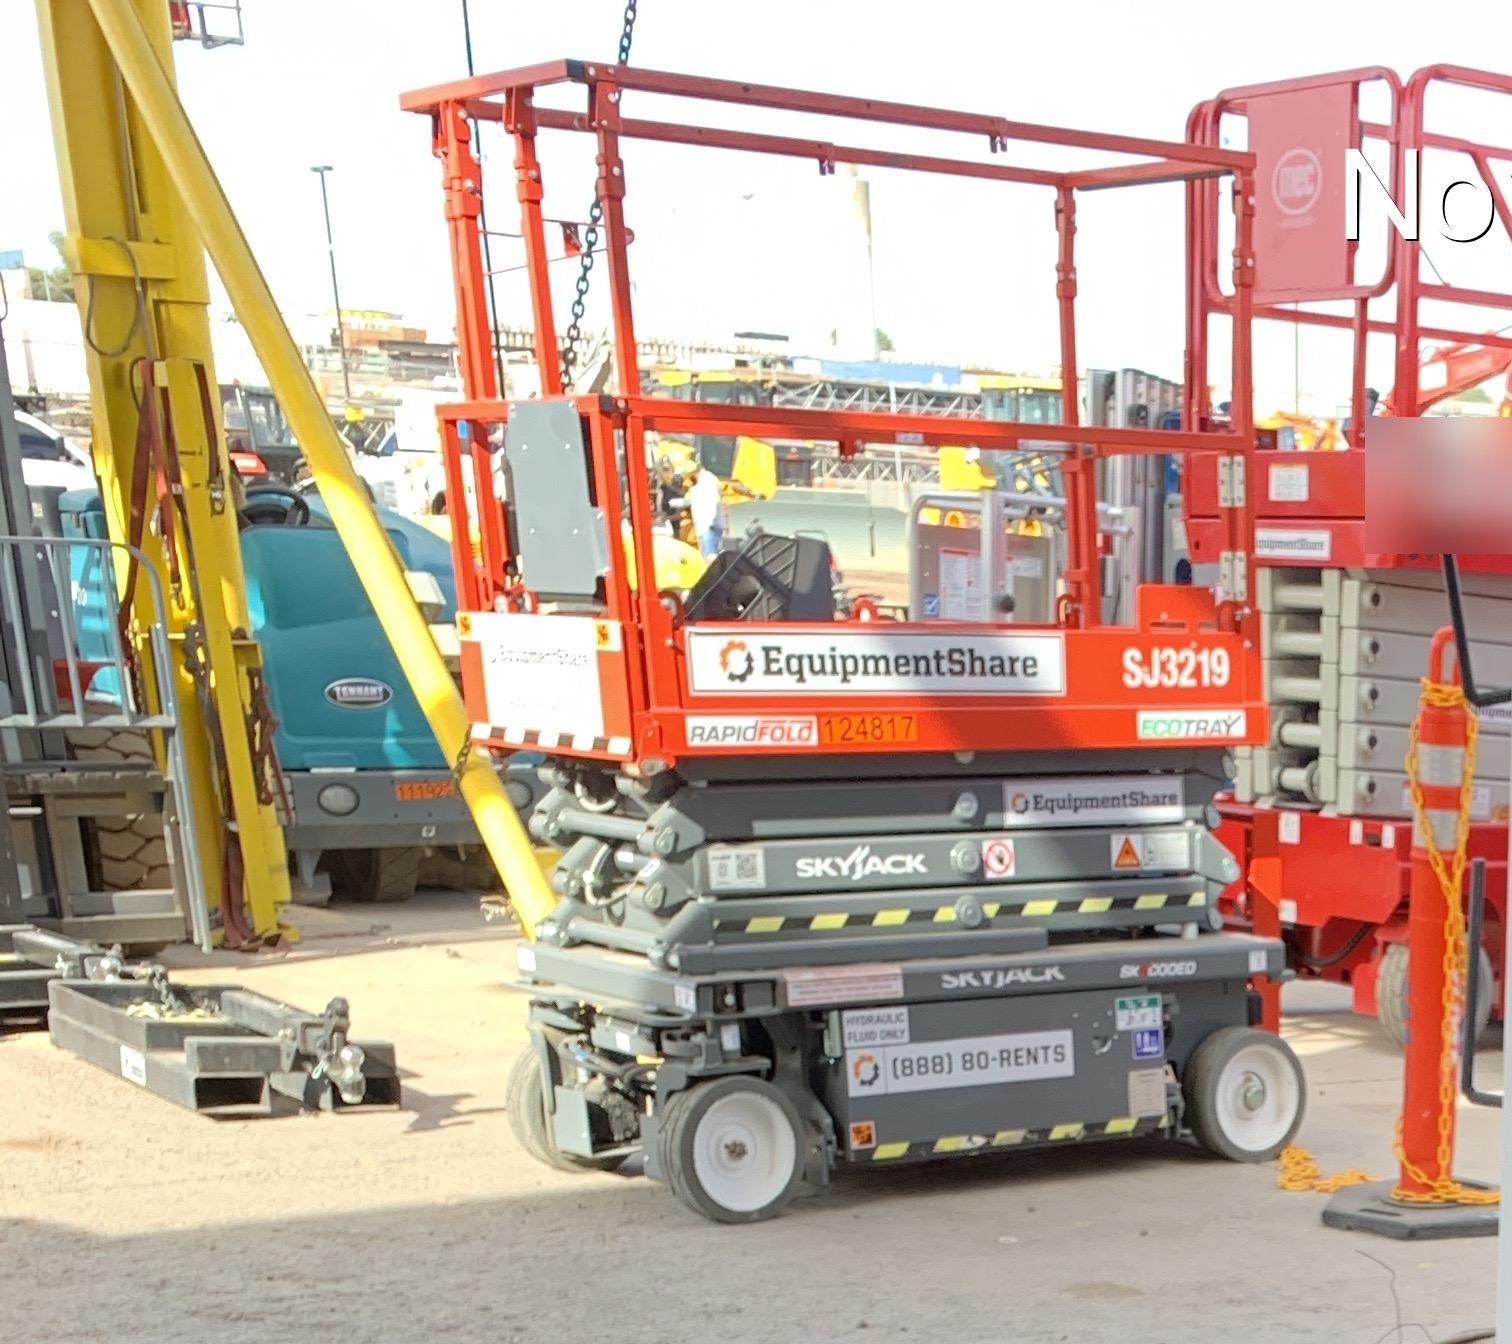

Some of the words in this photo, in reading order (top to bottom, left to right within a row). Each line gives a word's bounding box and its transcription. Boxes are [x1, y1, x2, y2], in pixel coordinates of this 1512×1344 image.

[761, 646, 1039, 684] EquipmentShare
[1122, 647, 1231, 688] SJ3219
[824, 716, 914, 743] 124817
[1142, 714, 1242, 737] ECOTRAY
[1033, 791, 1179, 813] EquipmentShare
[796, 846, 928, 880] SKYJACK
[845, 1012, 906, 1027] HYDRAULIC
[847, 1030, 877, 1042] FLUID
[879, 1028, 906, 1041] ONLY
[892, 1053, 953, 1080] (888)
[961, 1044, 1067, 1072] 80-RENTS
